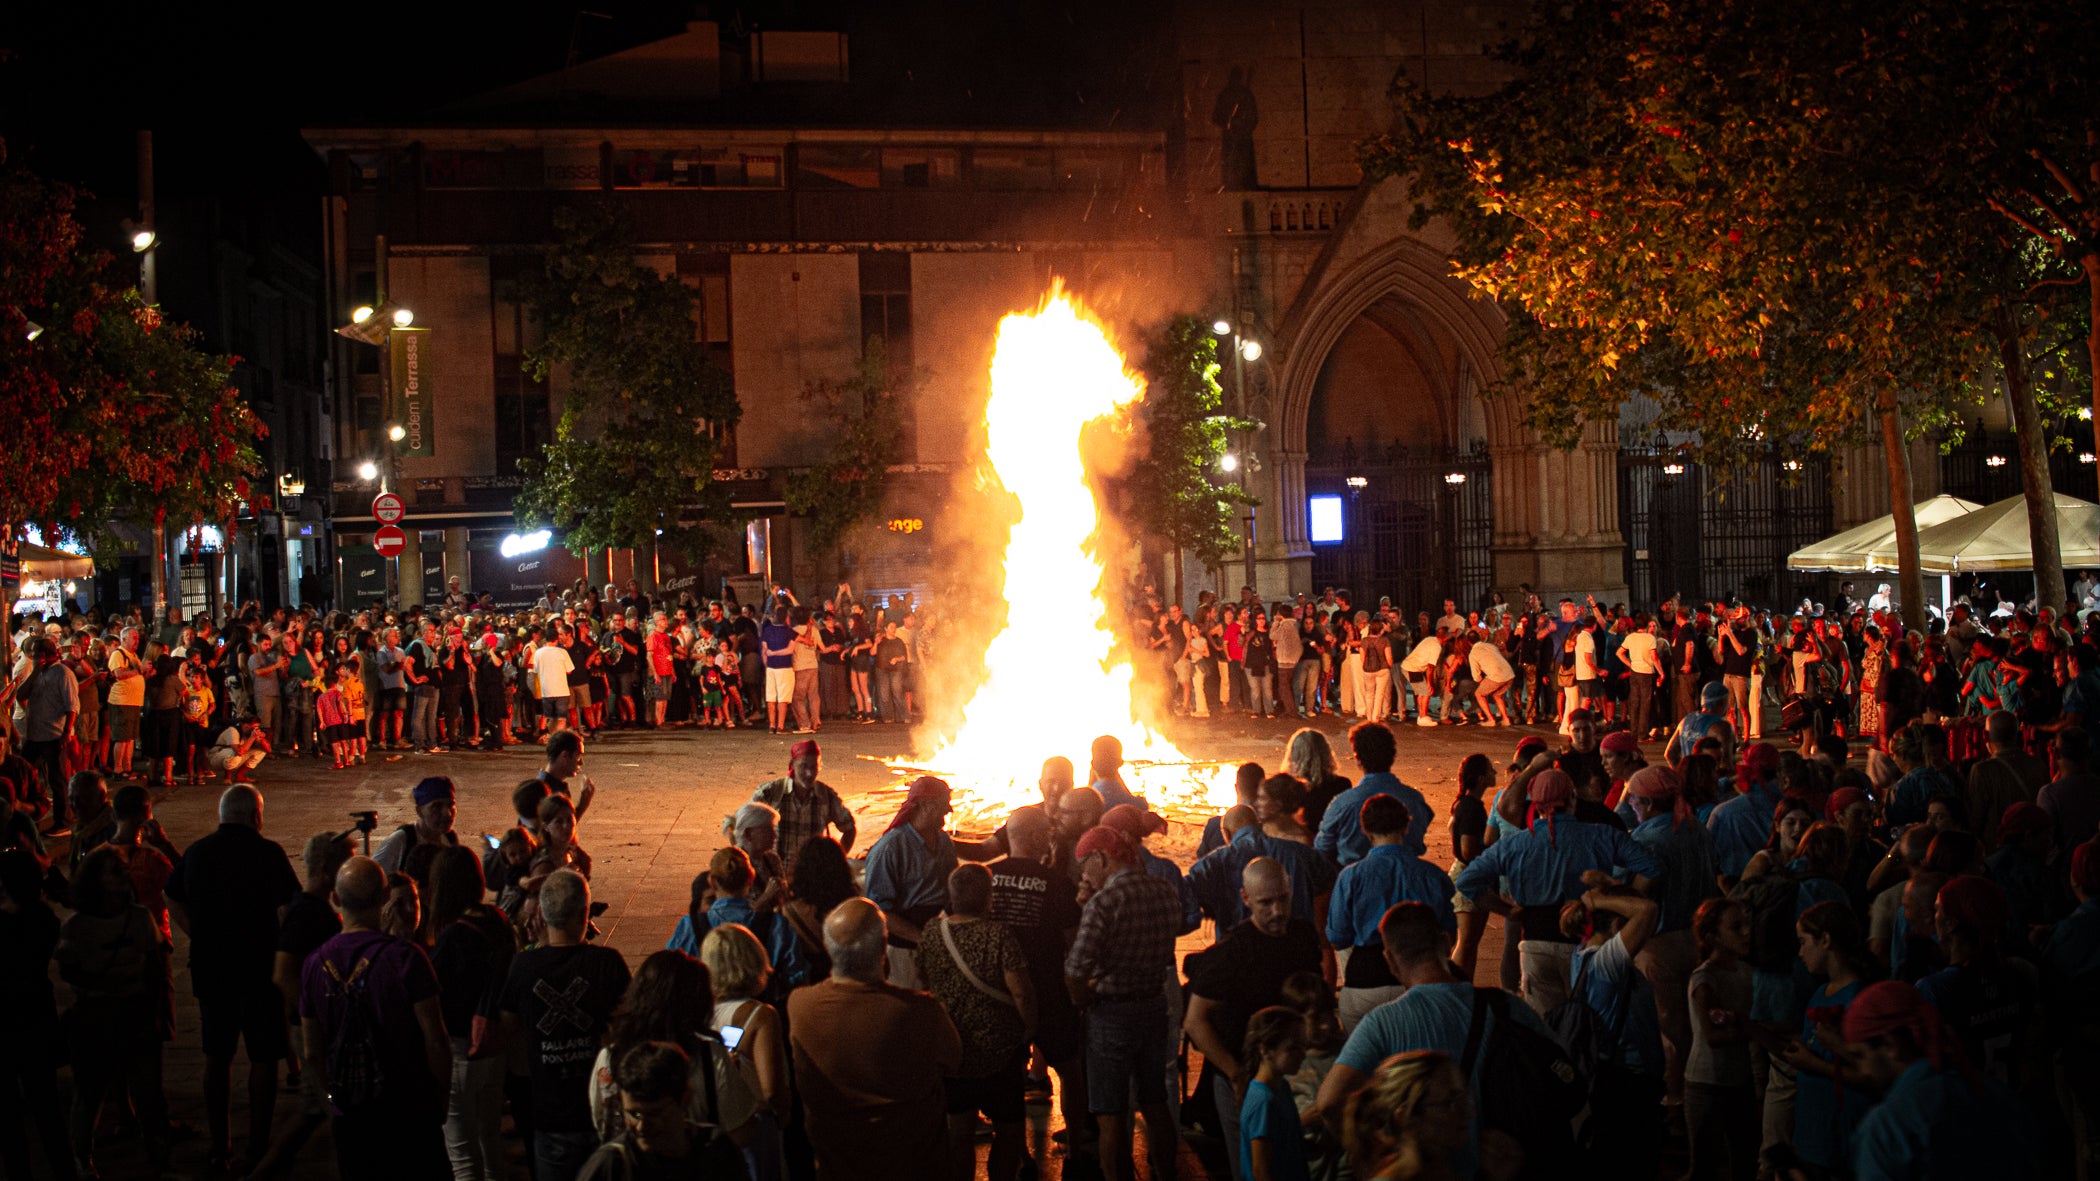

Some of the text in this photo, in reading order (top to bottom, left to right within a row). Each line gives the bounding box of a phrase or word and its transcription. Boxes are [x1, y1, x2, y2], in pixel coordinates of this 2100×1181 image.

[547, 165, 600, 180] rassa
[405, 336, 421, 450] cuidem Terrassa
[888, 518, 923, 534] nge
[666, 576, 697, 592] Cottet
[992, 875, 1047, 892] STELLERS
